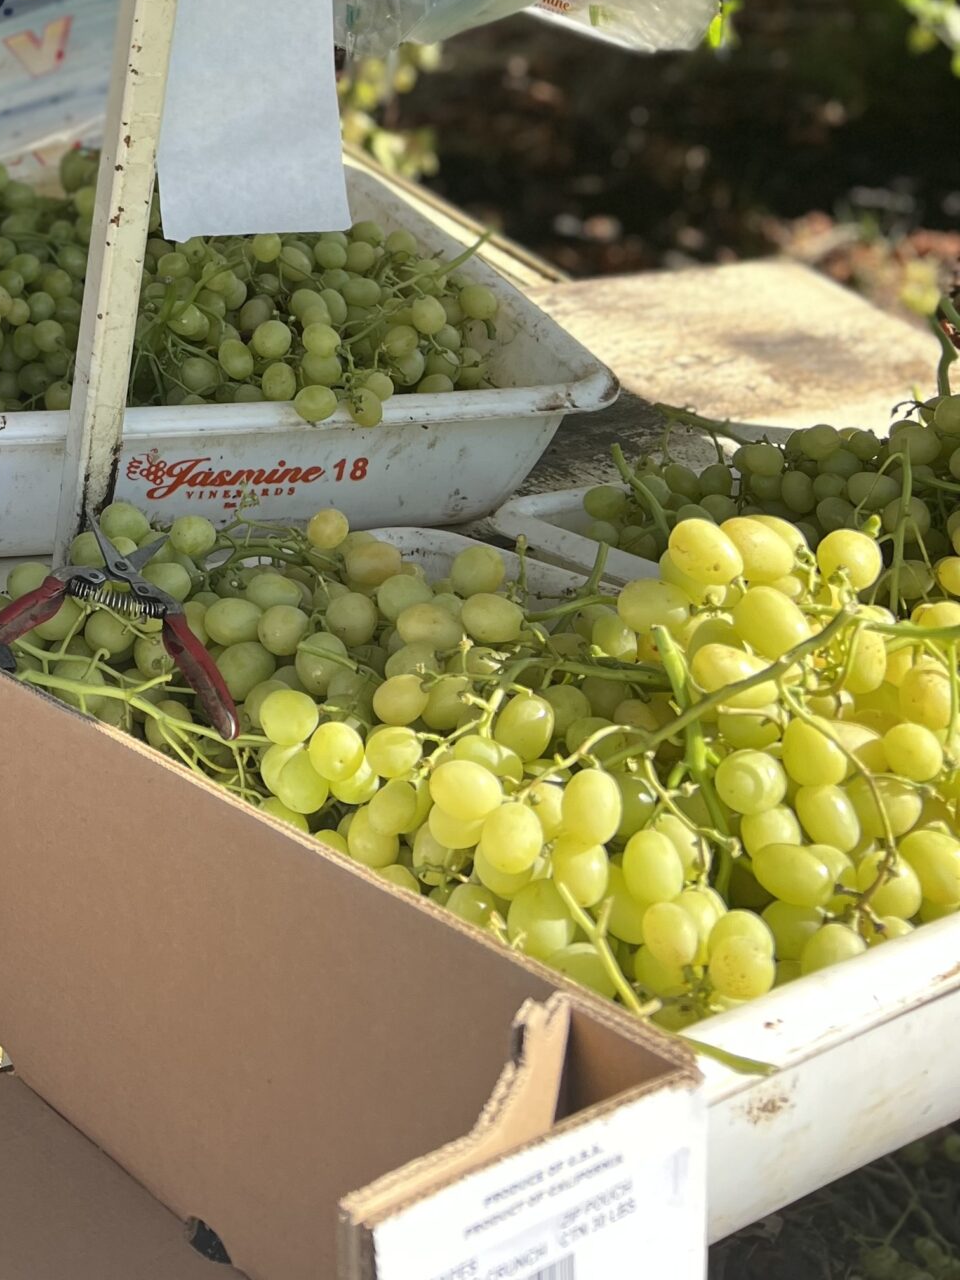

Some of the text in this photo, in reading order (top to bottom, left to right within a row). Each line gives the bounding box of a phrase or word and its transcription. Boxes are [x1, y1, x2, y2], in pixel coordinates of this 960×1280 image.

[146, 457, 369, 500] Jasmine 18
[483, 1171, 544, 1207] PRODUCE
[585, 1178, 633, 1214] POUCH
[464, 1201, 524, 1239] PRODUCT
